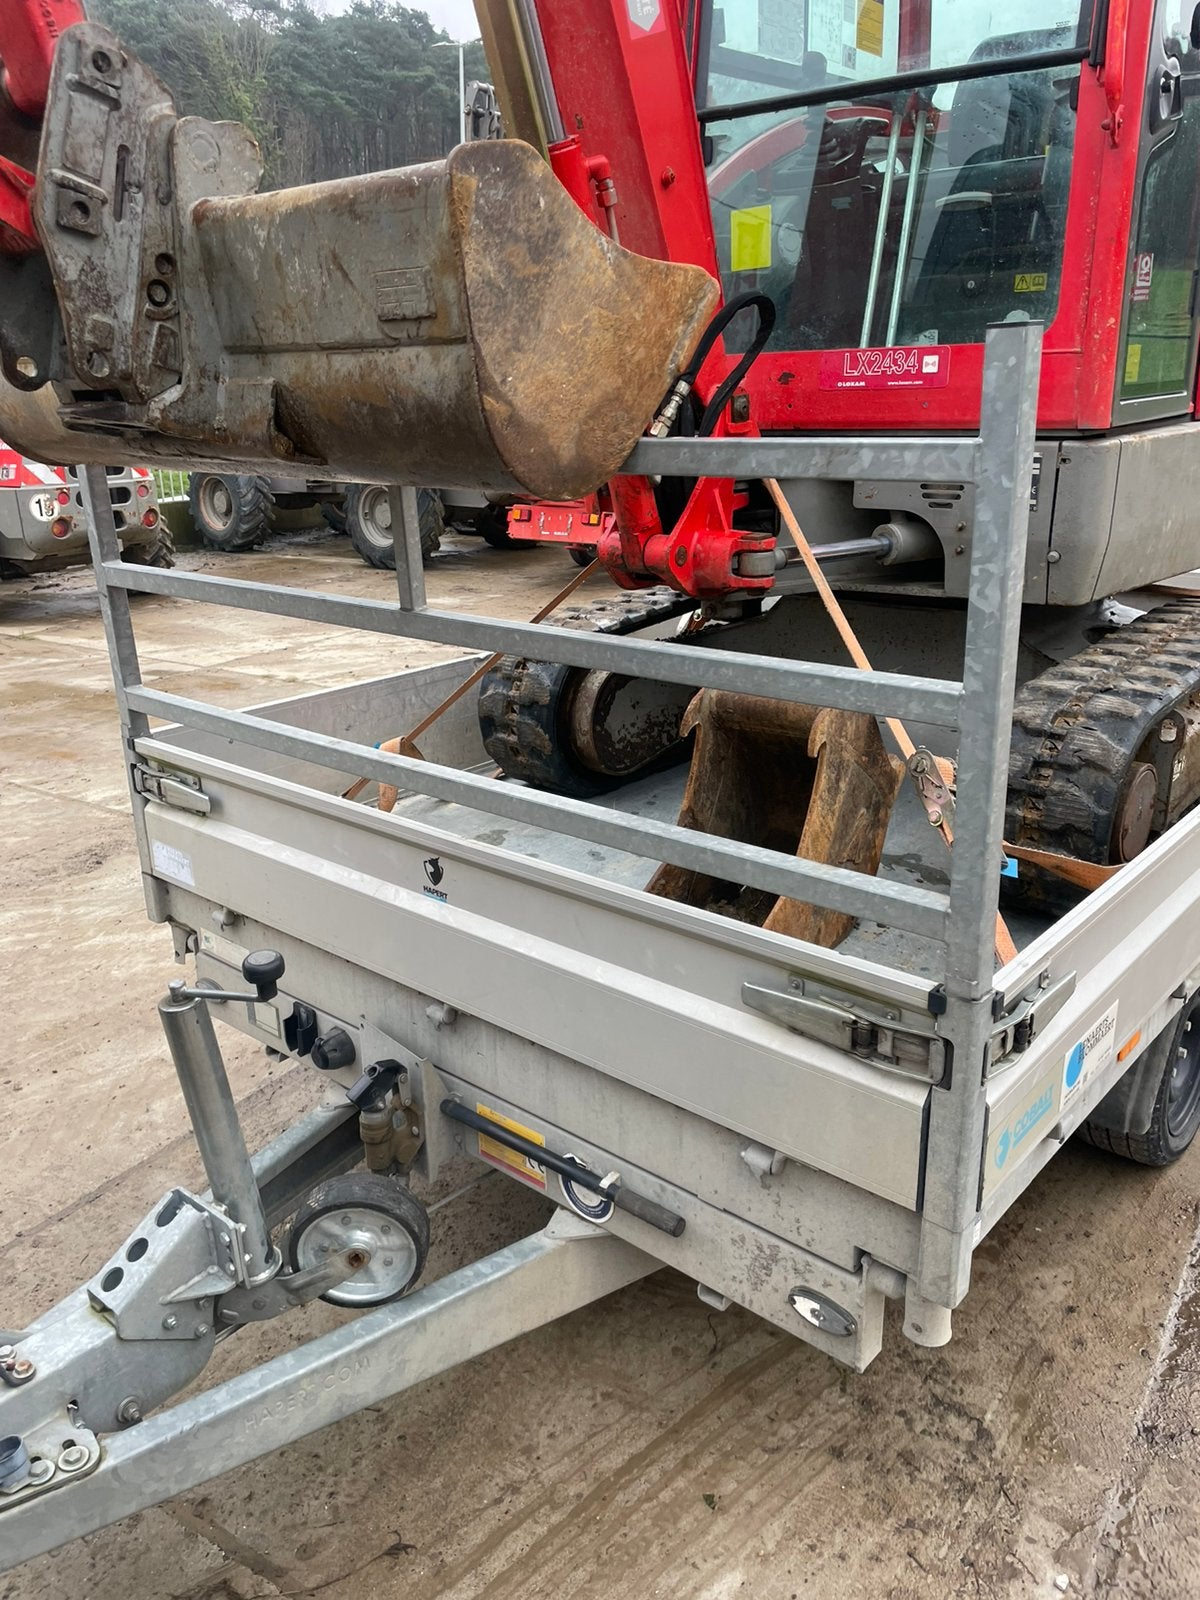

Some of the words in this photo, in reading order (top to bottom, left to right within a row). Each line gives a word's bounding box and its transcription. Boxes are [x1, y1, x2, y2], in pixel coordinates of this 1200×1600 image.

[843, 349, 919, 376] LX2434
[423, 885, 448, 900] HAPERT
[1013, 1083, 1055, 1139] COBALT
